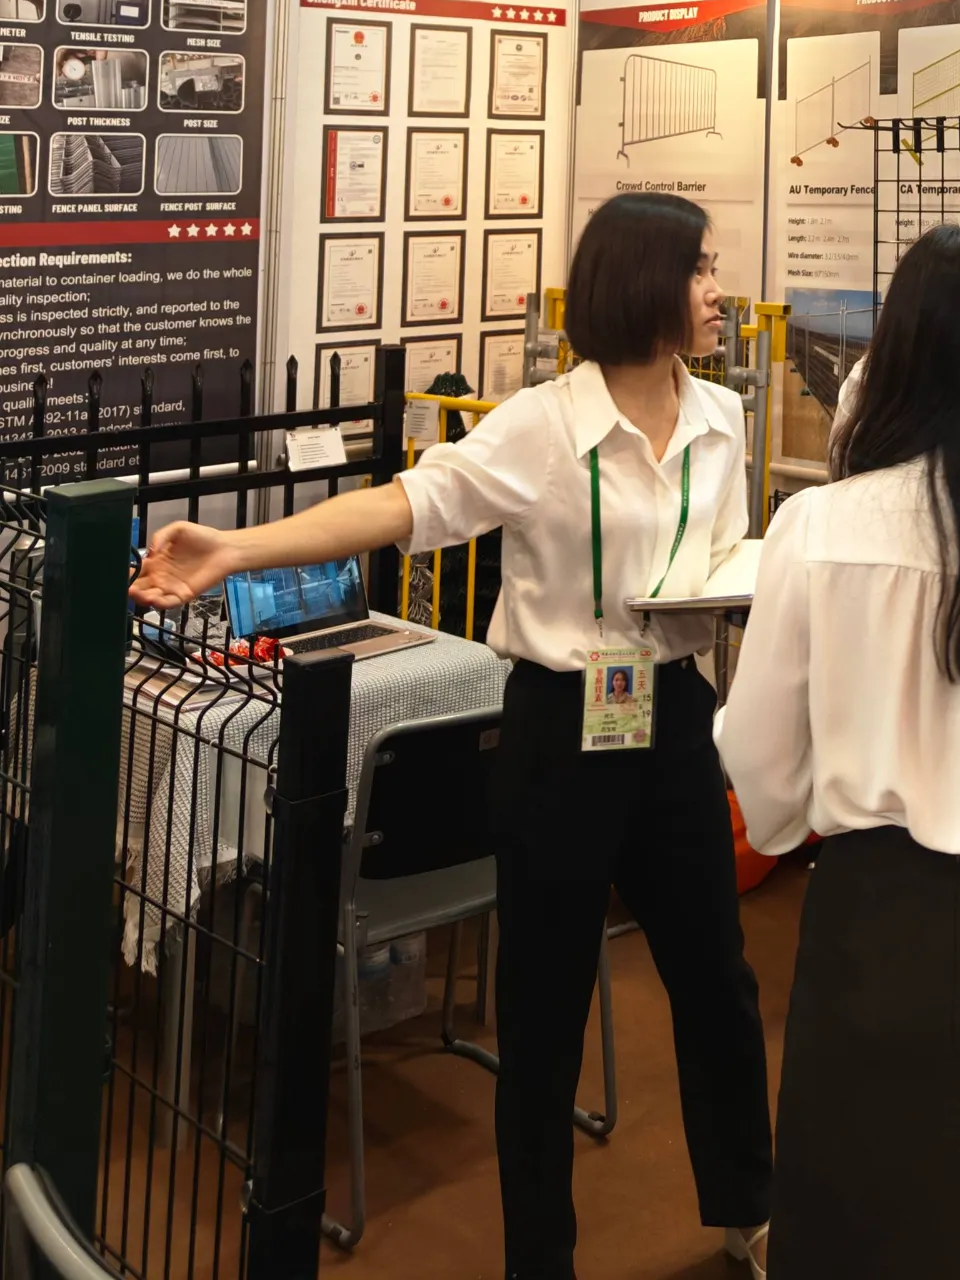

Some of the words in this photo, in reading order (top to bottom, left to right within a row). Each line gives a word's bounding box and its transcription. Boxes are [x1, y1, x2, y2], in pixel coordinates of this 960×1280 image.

[638, 9, 669, 22] PRODUCT
[669, 7, 698, 20] DISPLAY
[70, 31, 101, 42] TENSILE
[103, 33, 135, 43] TESTING
[187, 38, 204, 47] MESH
[205, 38, 221, 47] SIZE
[67, 117, 87, 127] POST
[89, 117, 130, 127] THICKNESS
[184, 119, 200, 127] POST
[202, 119, 218, 127] SIZE
[616, 181, 642, 191] Crowd
[645, 181, 674, 191] Control
[677, 181, 706, 192] Barrier
[789, 185, 801, 195] AU
[803, 185, 848, 197] Temporary
[850, 185, 875, 195] Fence
[900, 184, 913, 194] CA
[52, 204, 76, 213] FENCE
[78, 204, 102, 213] PANEL
[104, 203, 138, 213] SURFACE
[160, 202, 184, 211] FENCE
[184, 202, 203, 211] POST
[206, 202, 236, 211] SURFACE
[39, 251, 133, 269] Requirements:
[788, 252, 799, 260] Wire
[800, 252, 824, 260] diameter:
[46, 275, 57, 286] to
[60, 272, 115, 285] container
[119, 270, 163, 284] loading,
[166, 272, 183, 281] we
[186, 269, 200, 280] do
[203, 268, 220, 279] the
[223, 267, 252, 278] whole
[26, 291, 90, 306] inspection;
[17, 312, 27, 322] is
[30, 309, 88, 323] inspected
[92, 305, 132, 319] strictly,
[136, 304, 157, 315] and
[161, 301, 206, 315] reported
[210, 301, 220, 310] to
[223, 299, 239, 309] the
[80, 326, 94, 335] so
[98, 323, 120, 333] that
[124, 322, 141, 332] the
[145, 319, 196, 331] customer
[199, 316, 233, 327] knows
[236, 314, 251, 325] the
[53, 343, 76, 354] and
[79, 340, 118, 354] quality
[121, 340, 132, 349] at
[135, 338, 156, 351] any
[159, 336, 187, 348] time;
[21, 363, 46, 375] first,
[118, 353, 167, 366] interests
[170, 352, 200, 362] come
[203, 349, 226, 360] first,
[229, 347, 239, 358] to
[47, 393, 89, 406] meets:
